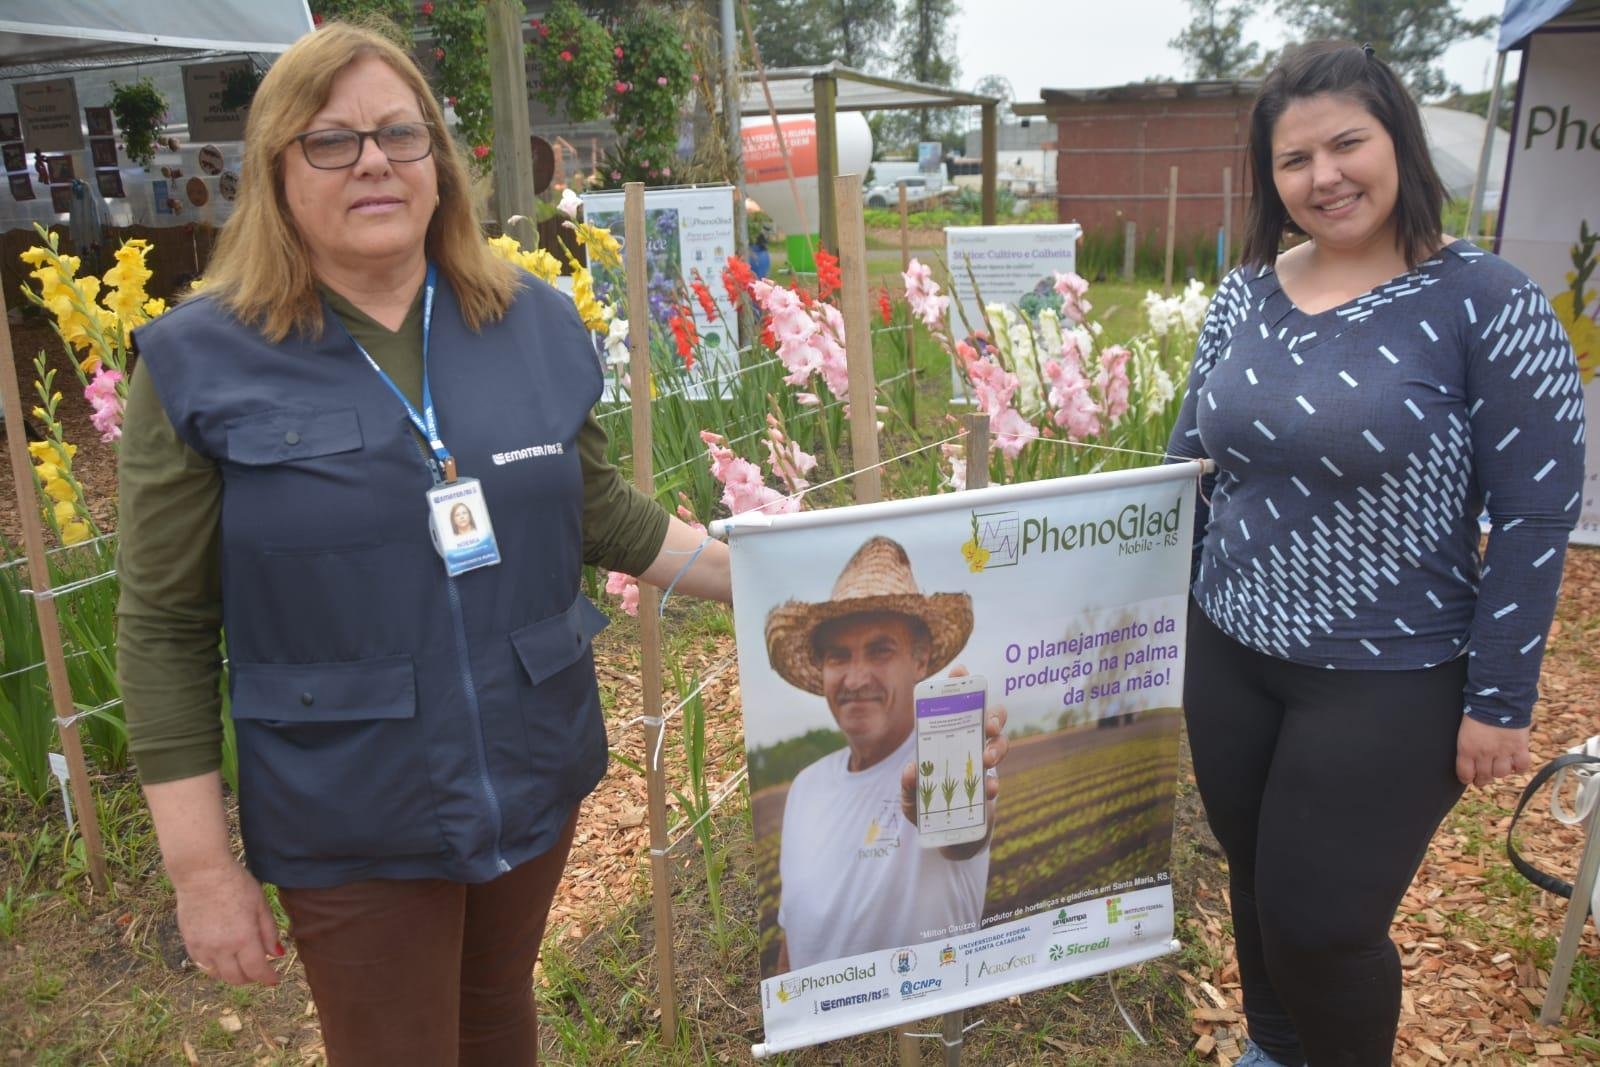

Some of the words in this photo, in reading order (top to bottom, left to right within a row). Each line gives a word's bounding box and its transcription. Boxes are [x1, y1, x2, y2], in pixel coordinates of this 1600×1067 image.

[987, 248, 1023, 259] Cultivo
[1031, 248, 1073, 259] Colheita
[1022, 497, 1182, 556] PhenoGlad
[1119, 540, 1153, 556] Mobile
[1164, 532, 1179, 547] RS
[1005, 643, 1021, 663] O
[1028, 621, 1148, 664] planejamento
[1154, 615, 1176, 634] da
[1005, 658, 1093, 696] produção
[1099, 655, 1119, 673] na
[1124, 644, 1178, 669] palma
[1063, 687, 1085, 706] da
[1090, 681, 1121, 700] sua
[1126, 668, 1171, 692] mão!
[981, 910, 1013, 926] produtor
[1014, 908, 1024, 916] de
[1024, 897, 1059, 912] hortaliças
[1100, 885, 1112, 893] em
[1113, 880, 1133, 891] Santa
[1134, 875, 1156, 887] Maria,
[1157, 872, 1170, 881] RS.
[958, 933, 1005, 950] UNIVERSIDADE
[1005, 926, 1031, 937] FEDERAL
[974, 944, 994, 952] SANTA
[995, 934, 1026, 947] CATARINA
[1066, 937, 1111, 956] Sicredi
[801, 963, 877, 993] PhenoGlad
[912, 978, 943, 992] CNPq
[830, 990, 882, 1010] EMATER/RS
